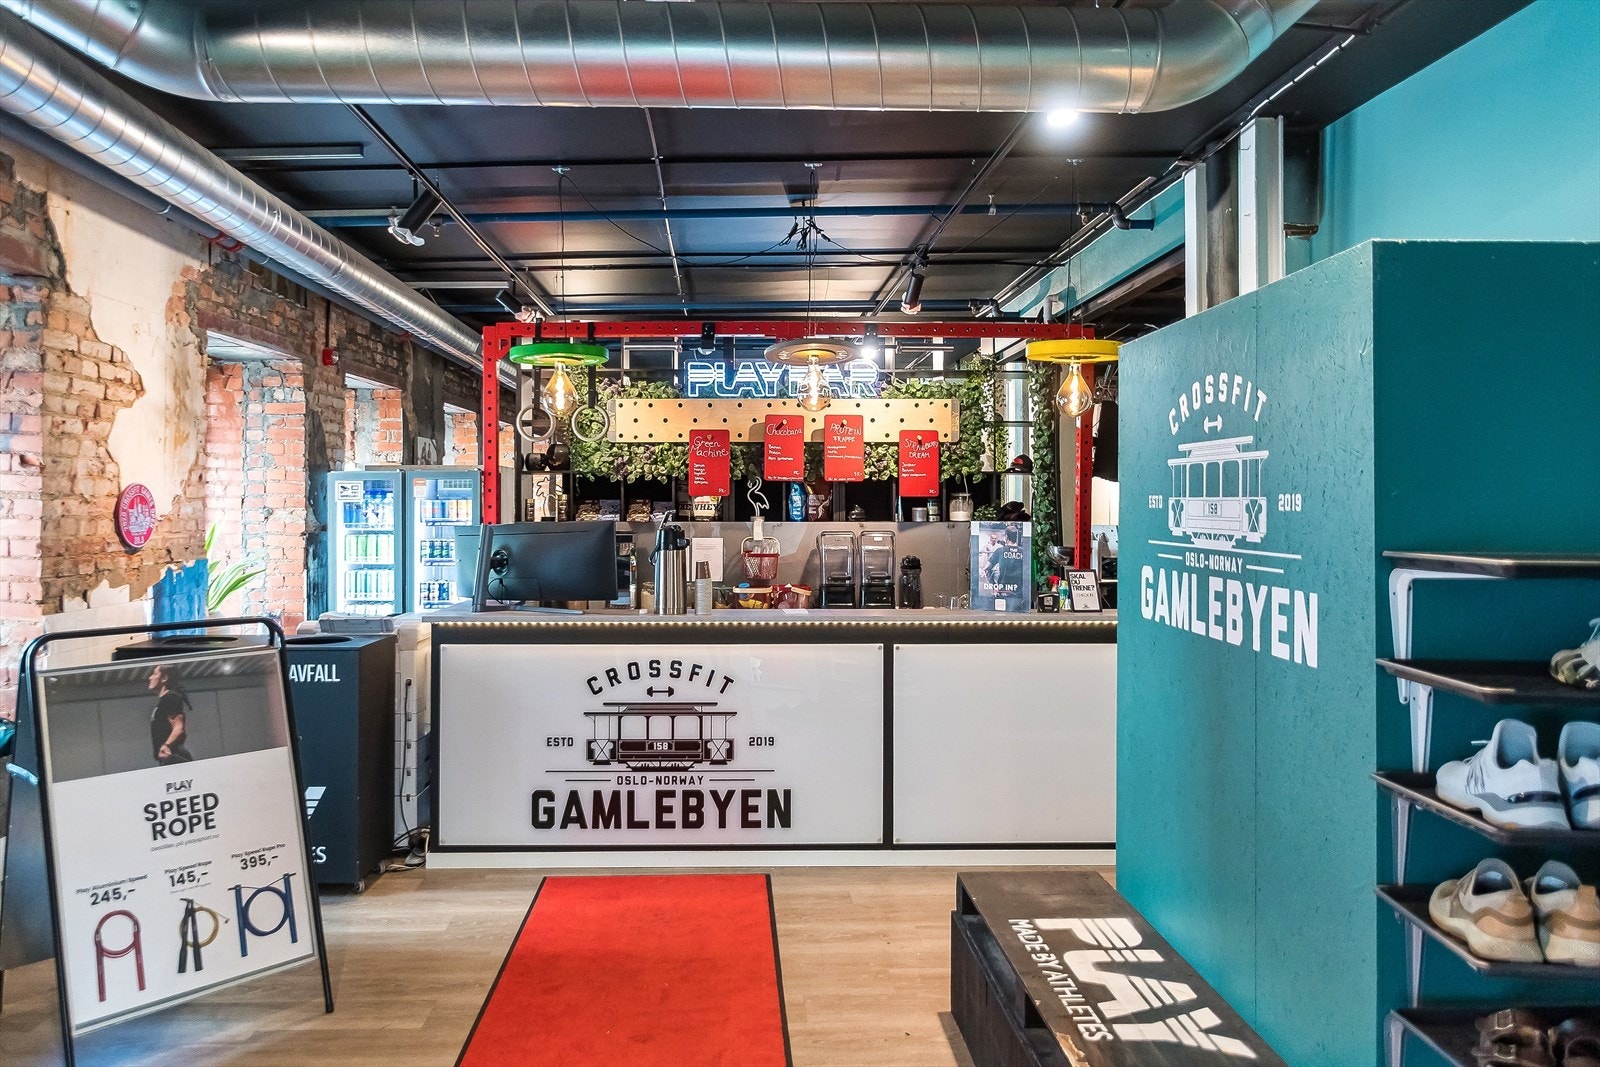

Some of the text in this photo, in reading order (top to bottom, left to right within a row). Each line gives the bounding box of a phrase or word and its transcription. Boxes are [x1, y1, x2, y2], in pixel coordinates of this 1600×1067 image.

[1168, 372, 1267, 436] CROSSFIT
[830, 422, 861, 436] PROTEIN
[693, 435, 721, 448] Green
[690, 445, 729, 458] Machine
[1148, 494, 1163, 509] ESTD
[1207, 502, 1218, 515] 158
[1278, 493, 1302, 512] 2019
[1185, 551, 1243, 574] OSLO-NORWAY
[1140, 565, 1319, 669] GAMLEBYEN
[586, 659, 735, 696] CROSSFIT
[546, 737, 574, 747] ESTD
[653, 741, 669, 750] 158
[748, 736, 775, 747] 2019
[166, 779, 193, 792] PLAY
[616, 775, 704, 786] OSLO-NORWAY
[144, 792, 220, 822] SPEED
[531, 788, 792, 829] GAMLEBYEN
[152, 811, 217, 841] ROPE
[240, 853, 279, 870] 395,-
[169, 870, 208, 887] 145,-
[90, 887, 136, 906] 245,-
[1008, 919, 1115, 1041] MADE BY ATHLETES
[1032, 917, 1258, 1060] PLAY
